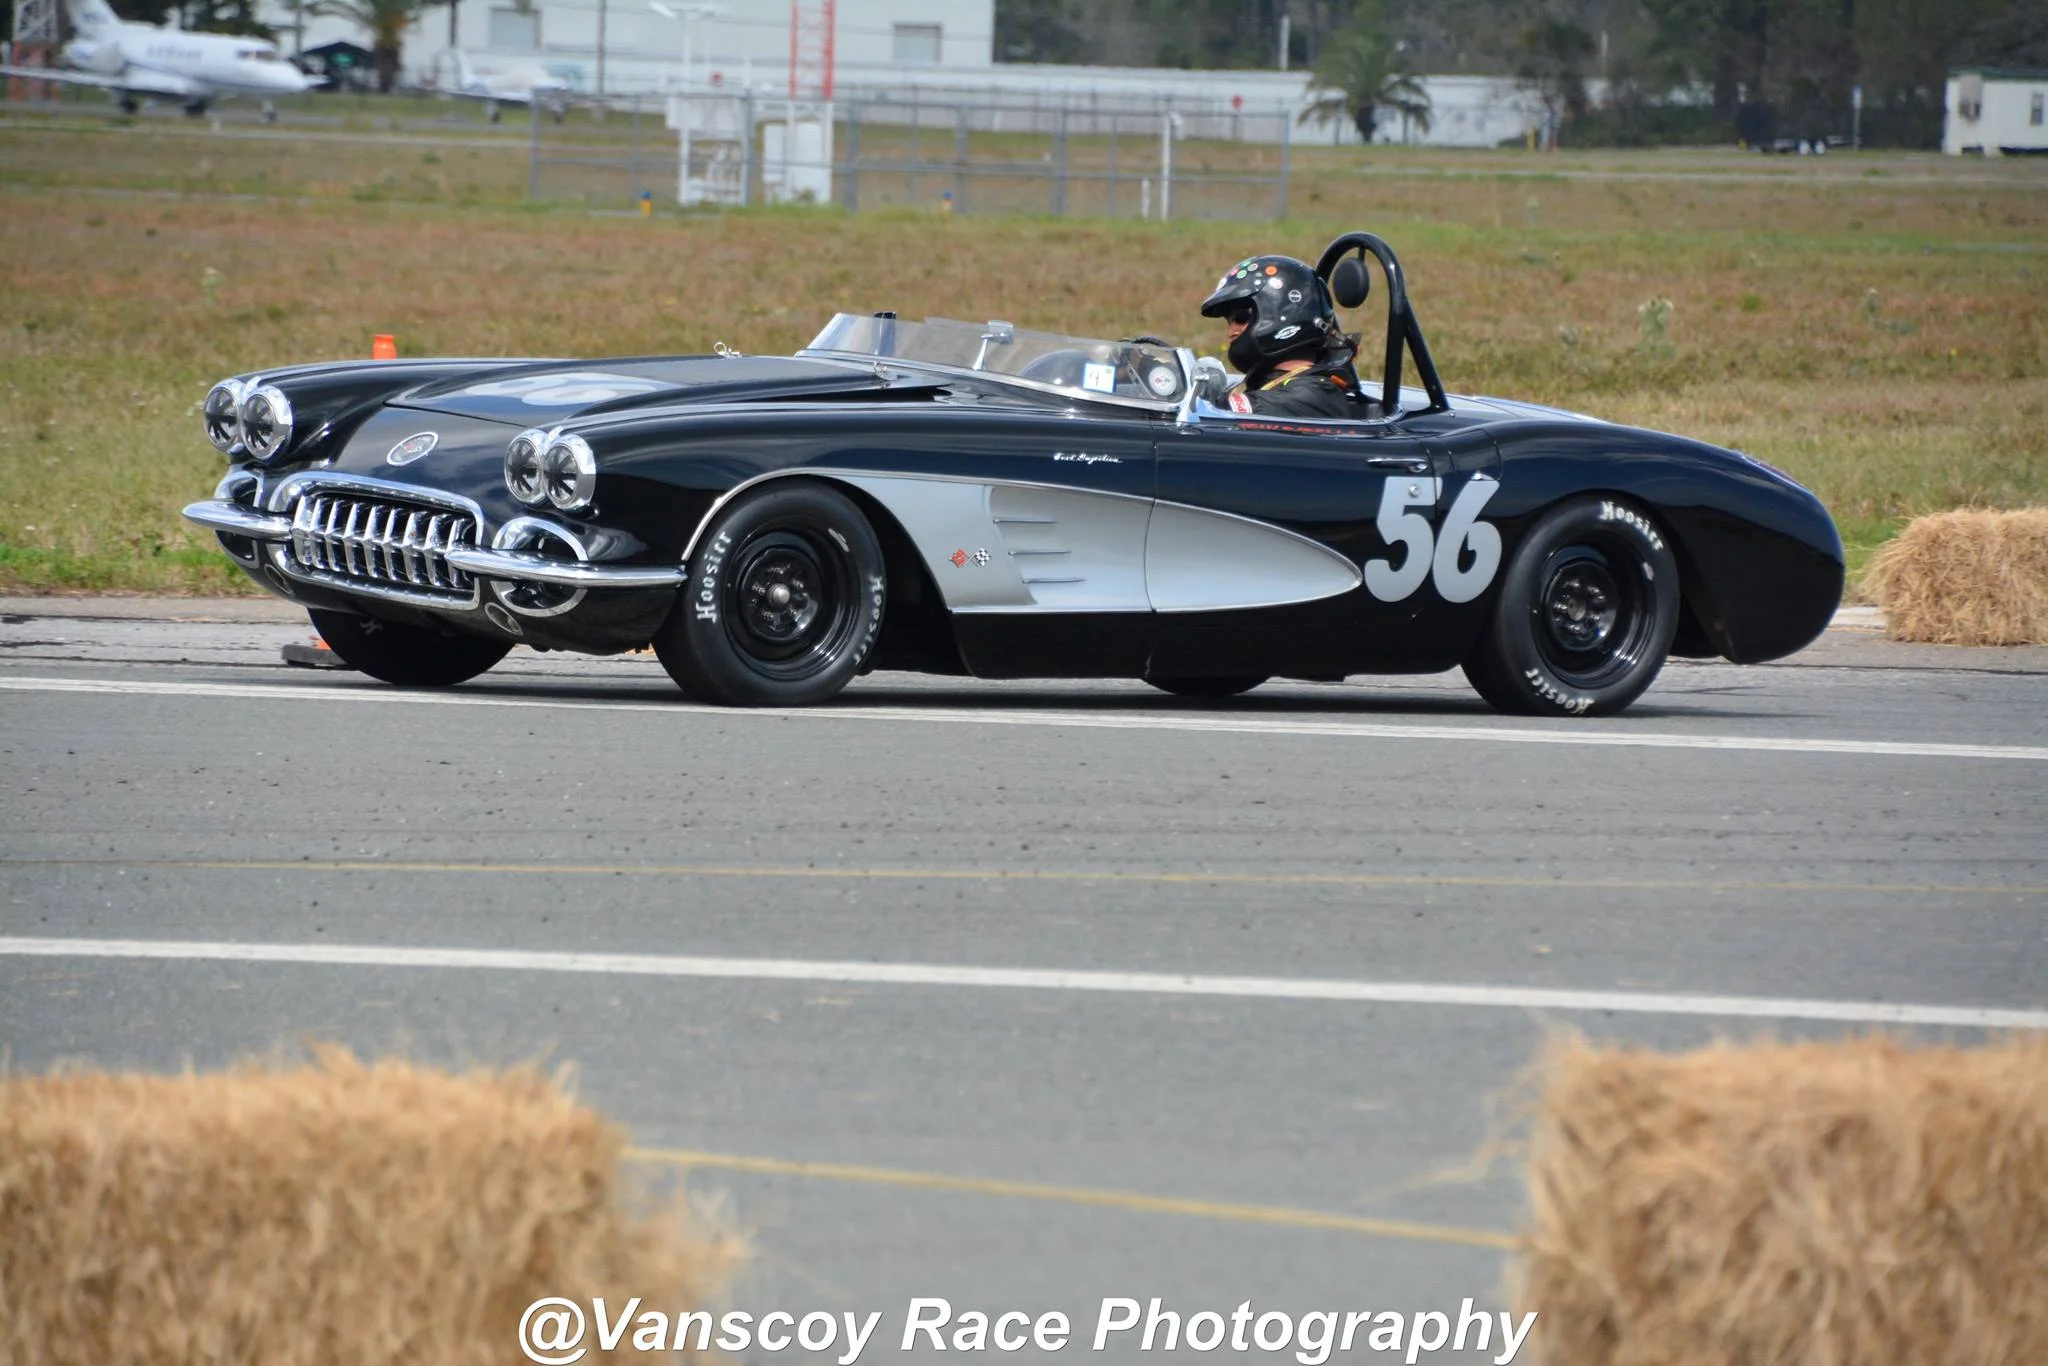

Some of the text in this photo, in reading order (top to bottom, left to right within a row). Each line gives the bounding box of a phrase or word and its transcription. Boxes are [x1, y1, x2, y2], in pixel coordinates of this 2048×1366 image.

[1364, 476, 1503, 604] 56
[1599, 501, 1664, 551] Hoosier
[695, 531, 732, 624] Hoosier
[854, 575, 884, 666] Hoosier
[1525, 667, 1595, 714] Hoosier
